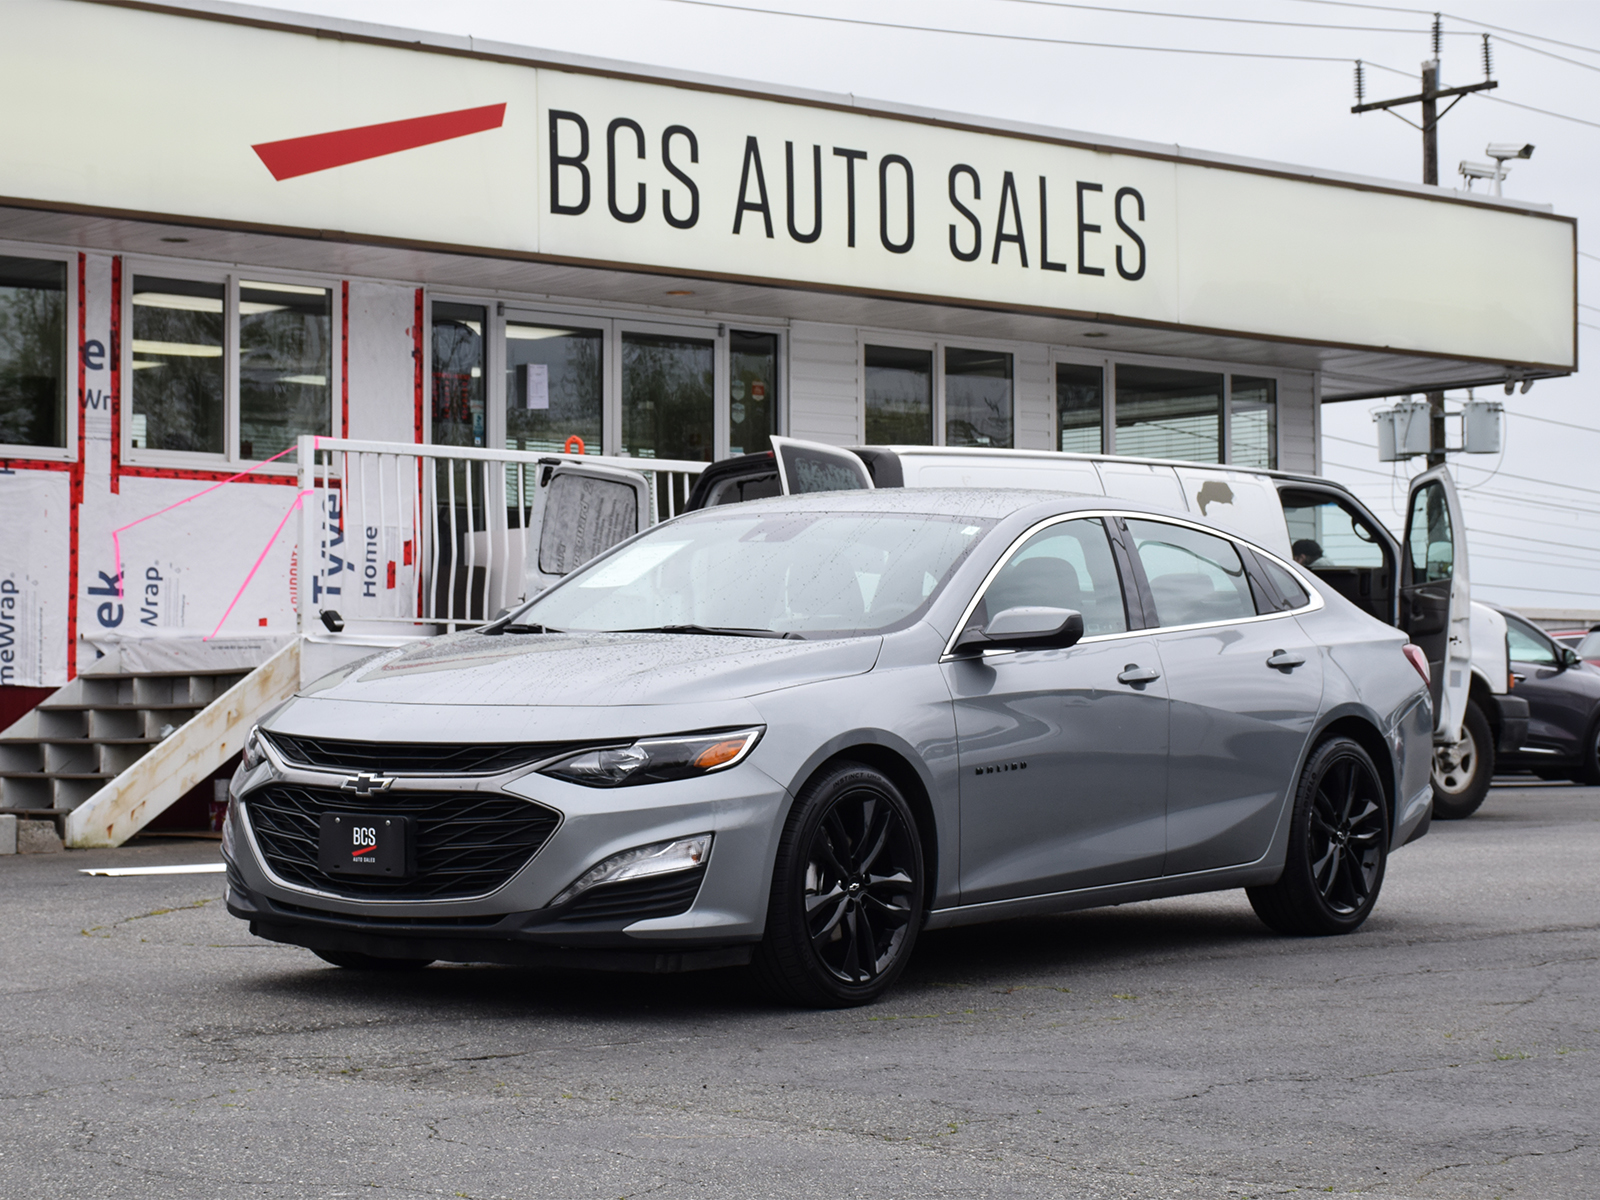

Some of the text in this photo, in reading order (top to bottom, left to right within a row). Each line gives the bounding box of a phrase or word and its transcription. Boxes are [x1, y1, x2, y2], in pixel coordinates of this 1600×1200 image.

[548, 108, 1147, 282] BCS AUTO SALES
[363, 527, 378, 597] Home
[140, 566, 164, 628] Wrap
[353, 827, 376, 845] BCS
